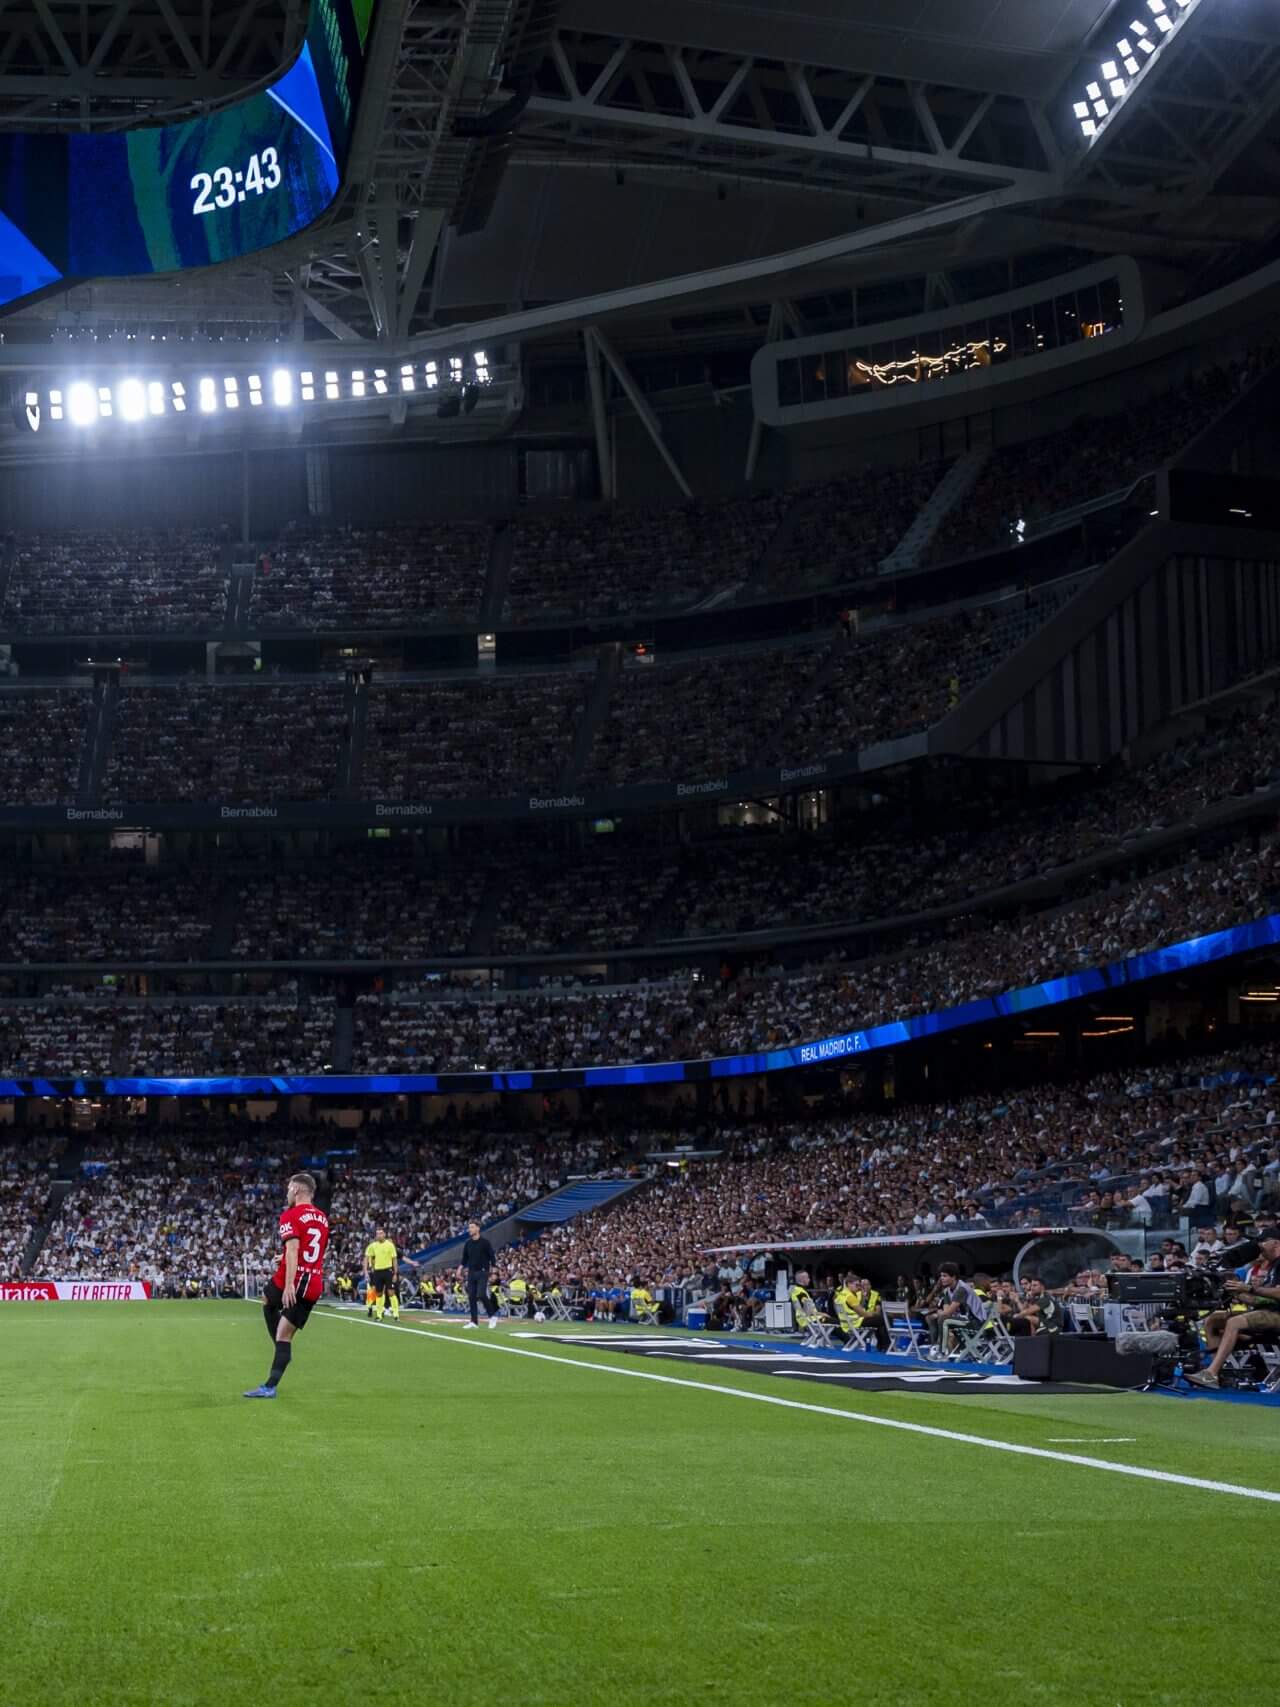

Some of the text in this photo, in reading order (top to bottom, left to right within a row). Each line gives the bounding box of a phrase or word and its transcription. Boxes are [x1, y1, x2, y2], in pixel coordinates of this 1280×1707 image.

[190, 146, 282, 215] 23:43
[529, 795, 584, 809] Bernabéu
[66, 808, 123, 820] Bernabéu
[221, 806, 277, 817] Bernabéu
[375, 804, 432, 815] Bernabéu
[801, 1047, 818, 1063] REAL
[819, 1040, 845, 1058] MADRID
[303, 1227, 321, 1263] 3
[72, 1285, 132, 1300] FLY BETTER
